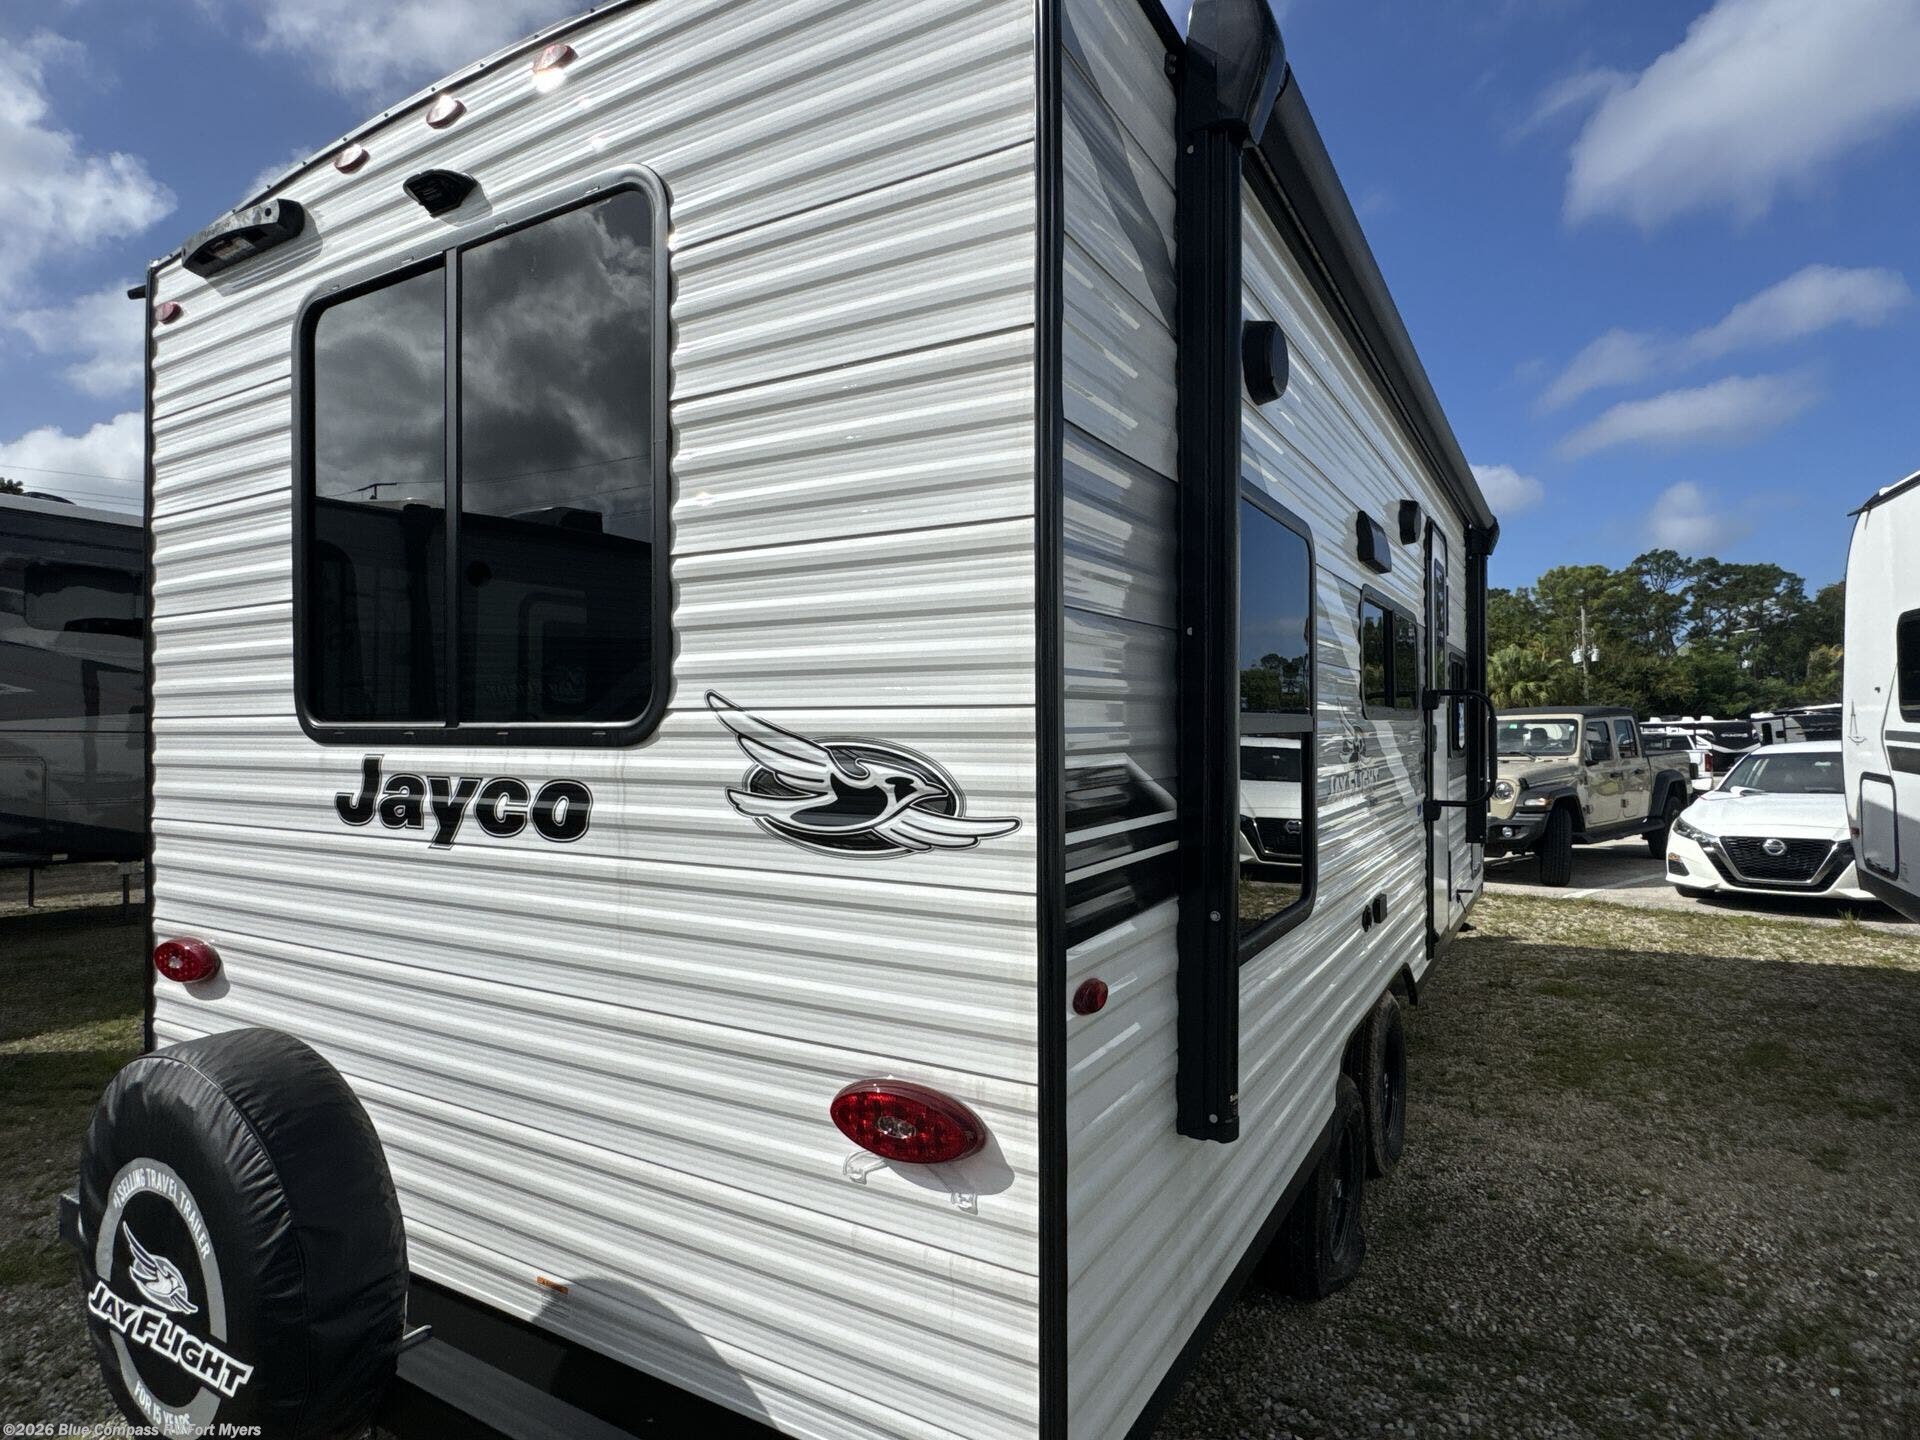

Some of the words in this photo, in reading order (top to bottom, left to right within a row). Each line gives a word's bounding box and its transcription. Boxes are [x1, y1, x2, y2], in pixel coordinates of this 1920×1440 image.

[334, 754, 594, 850] Jayco
[116, 1168, 145, 1200] SELLING
[146, 1168, 178, 1202] TRAVEL
[179, 1191, 211, 1260] TRAILER
[134, 1380, 152, 1415] FOR
[153, 1403, 161, 1425] 15
